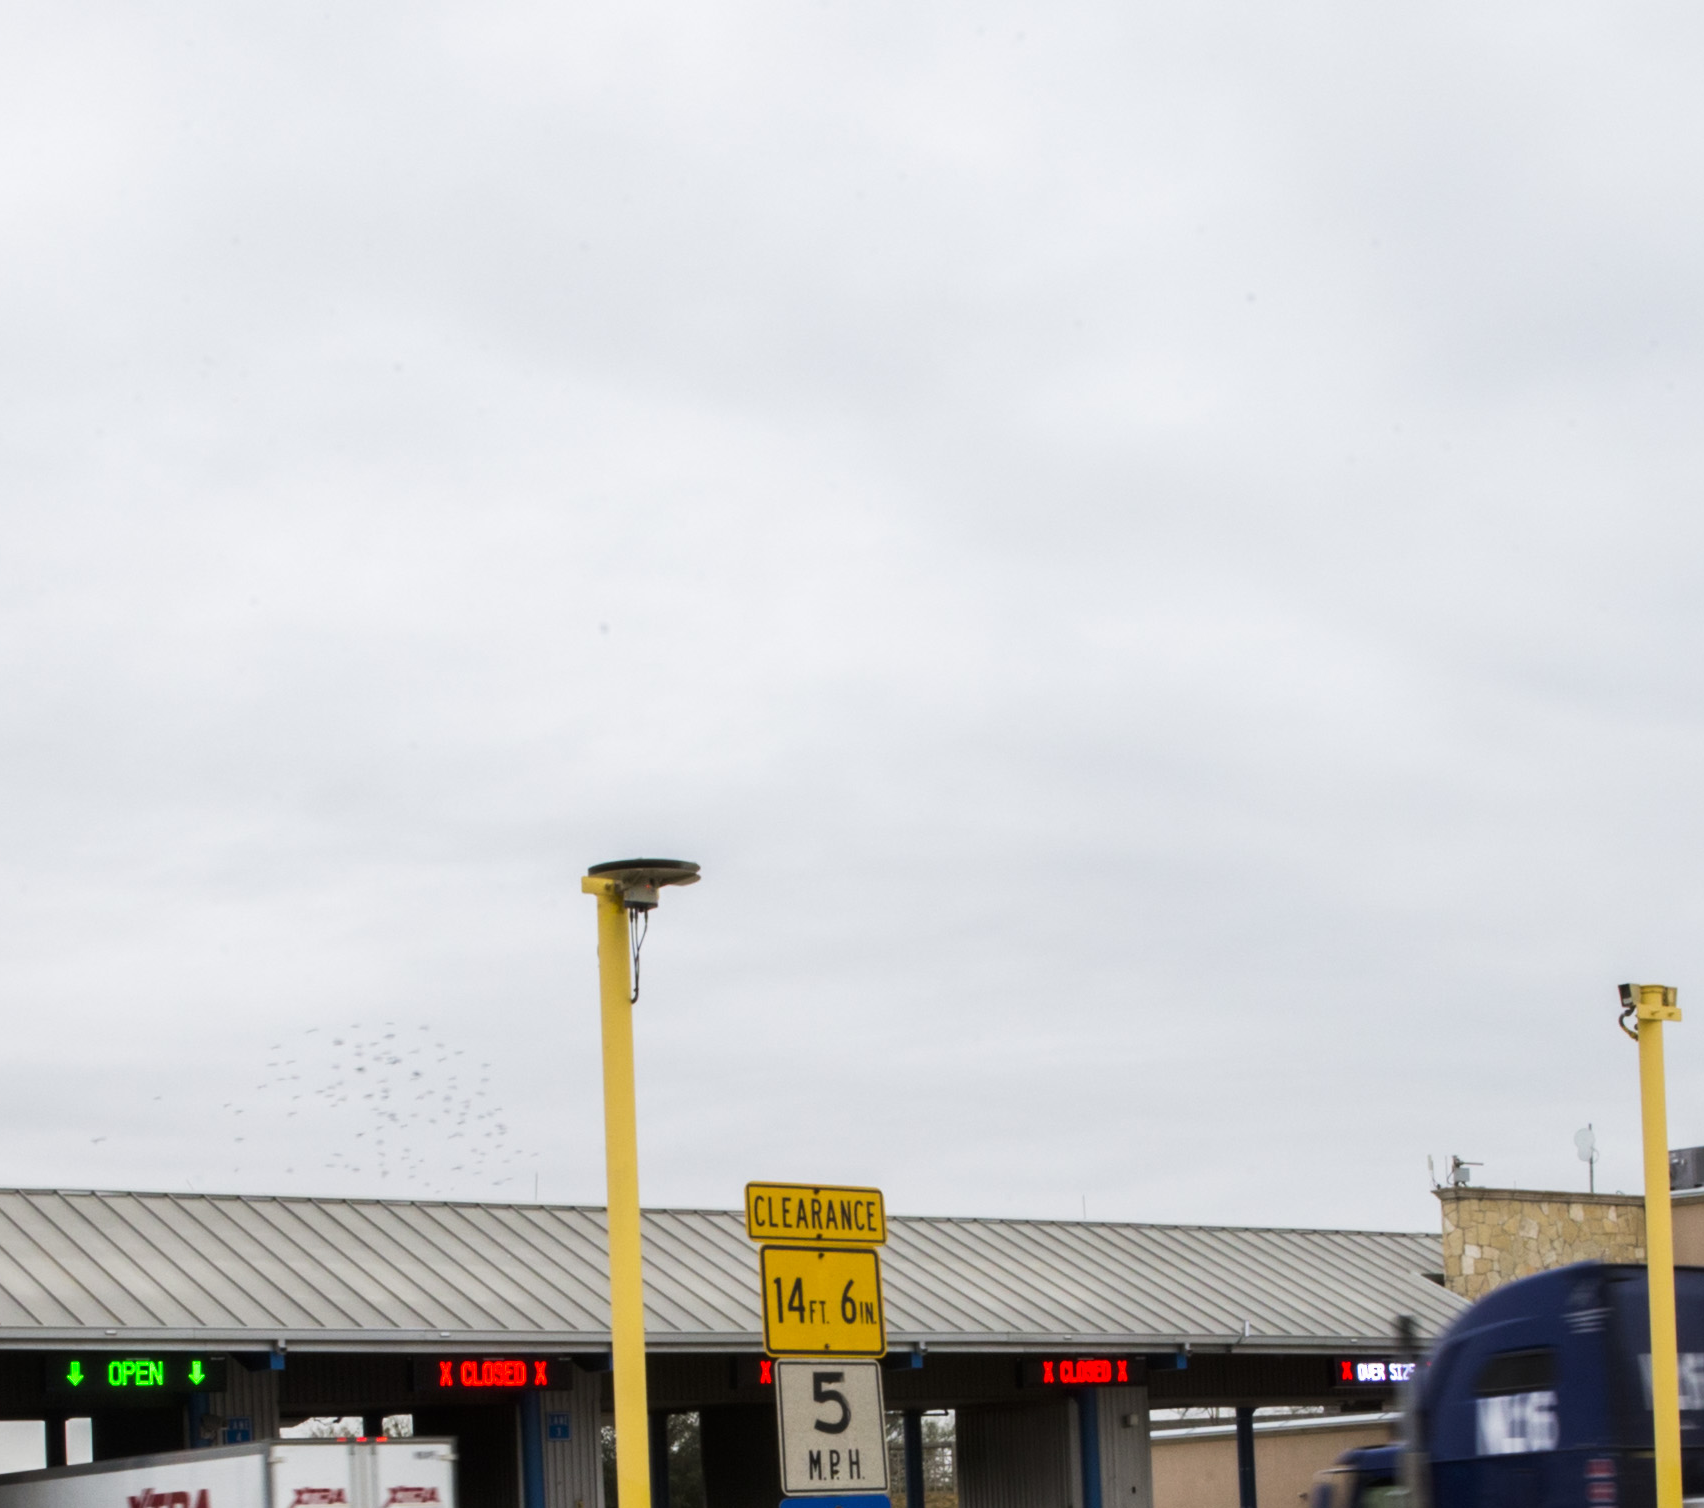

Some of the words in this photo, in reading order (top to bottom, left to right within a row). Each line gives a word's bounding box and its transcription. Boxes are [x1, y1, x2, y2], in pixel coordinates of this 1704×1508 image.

[754, 1195, 877, 1232] CLEARANCE
[773, 1276, 806, 1324] 14
[107, 1360, 164, 1386] OPEN
[460, 1360, 528, 1387] CLOSED
[1059, 1360, 1112, 1384] CLOSED
[1357, 1362, 1386, 1382] OVER
[812, 1371, 852, 1435] 5
[808, 1449, 865, 1481] M.P.H.
